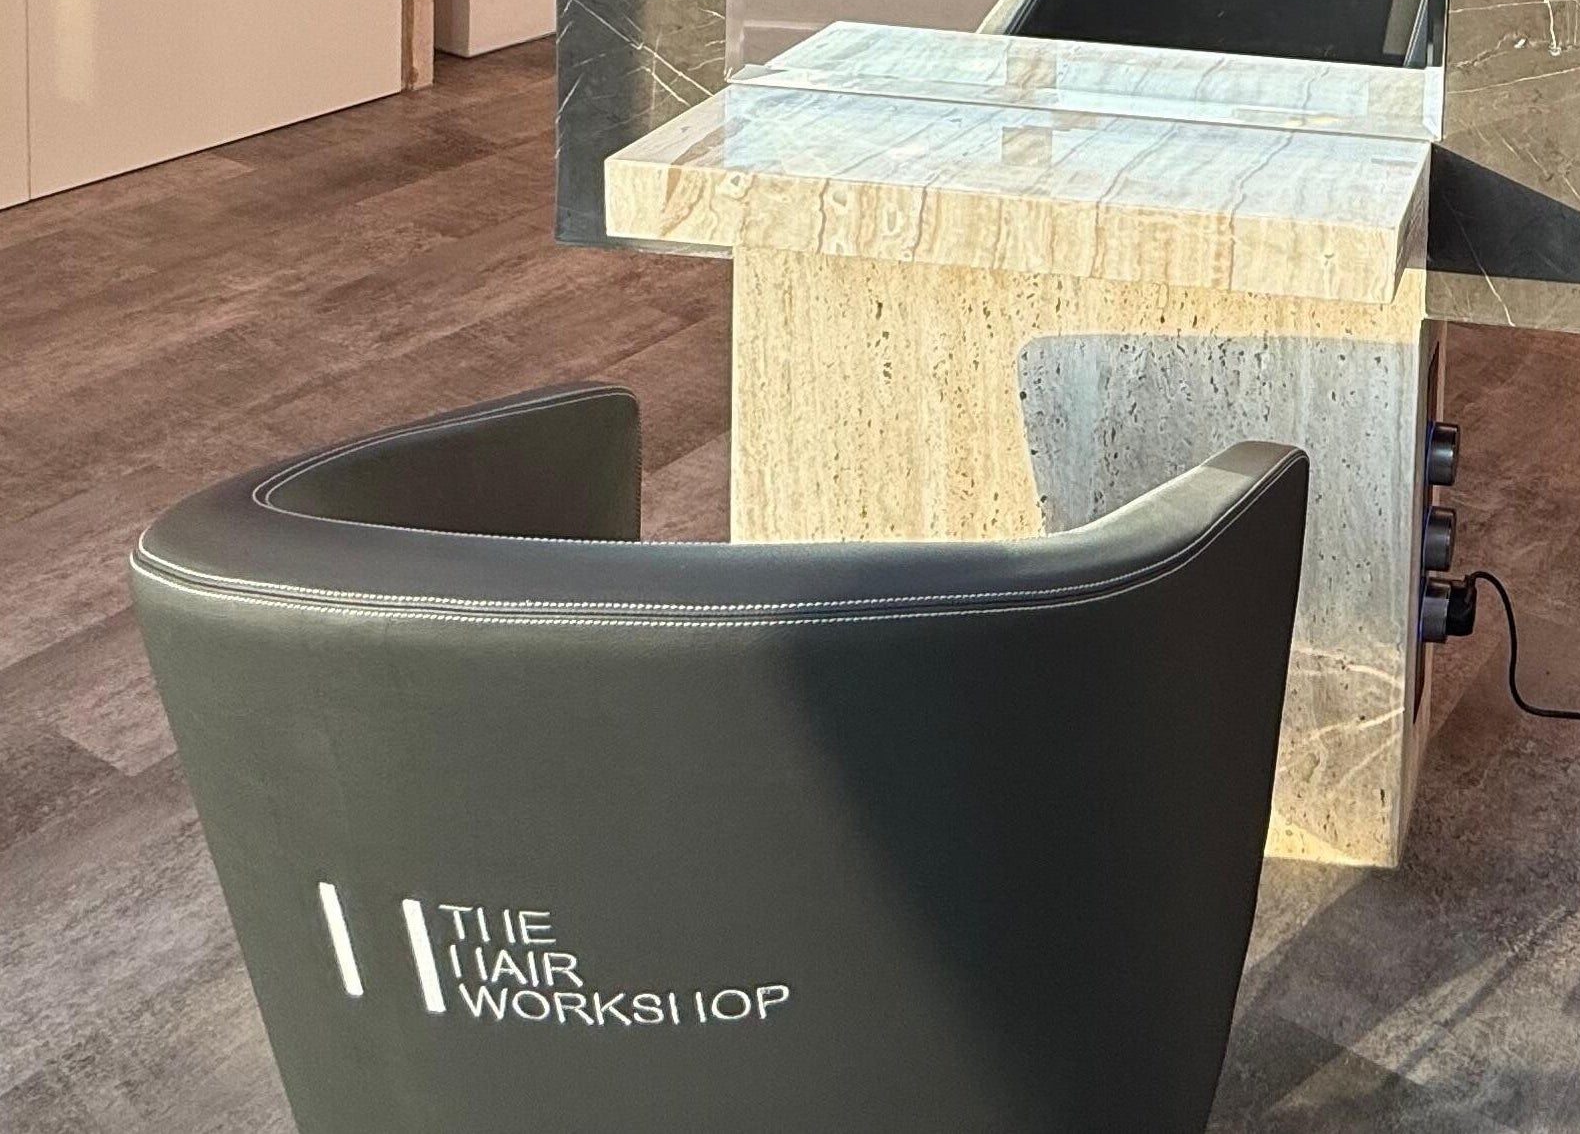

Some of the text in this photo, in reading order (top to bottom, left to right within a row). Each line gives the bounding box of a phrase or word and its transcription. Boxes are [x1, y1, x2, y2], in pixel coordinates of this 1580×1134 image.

[438, 903, 557, 945] THE
[449, 943, 584, 987] HAIR
[458, 983, 791, 1026] WORKSHOP
